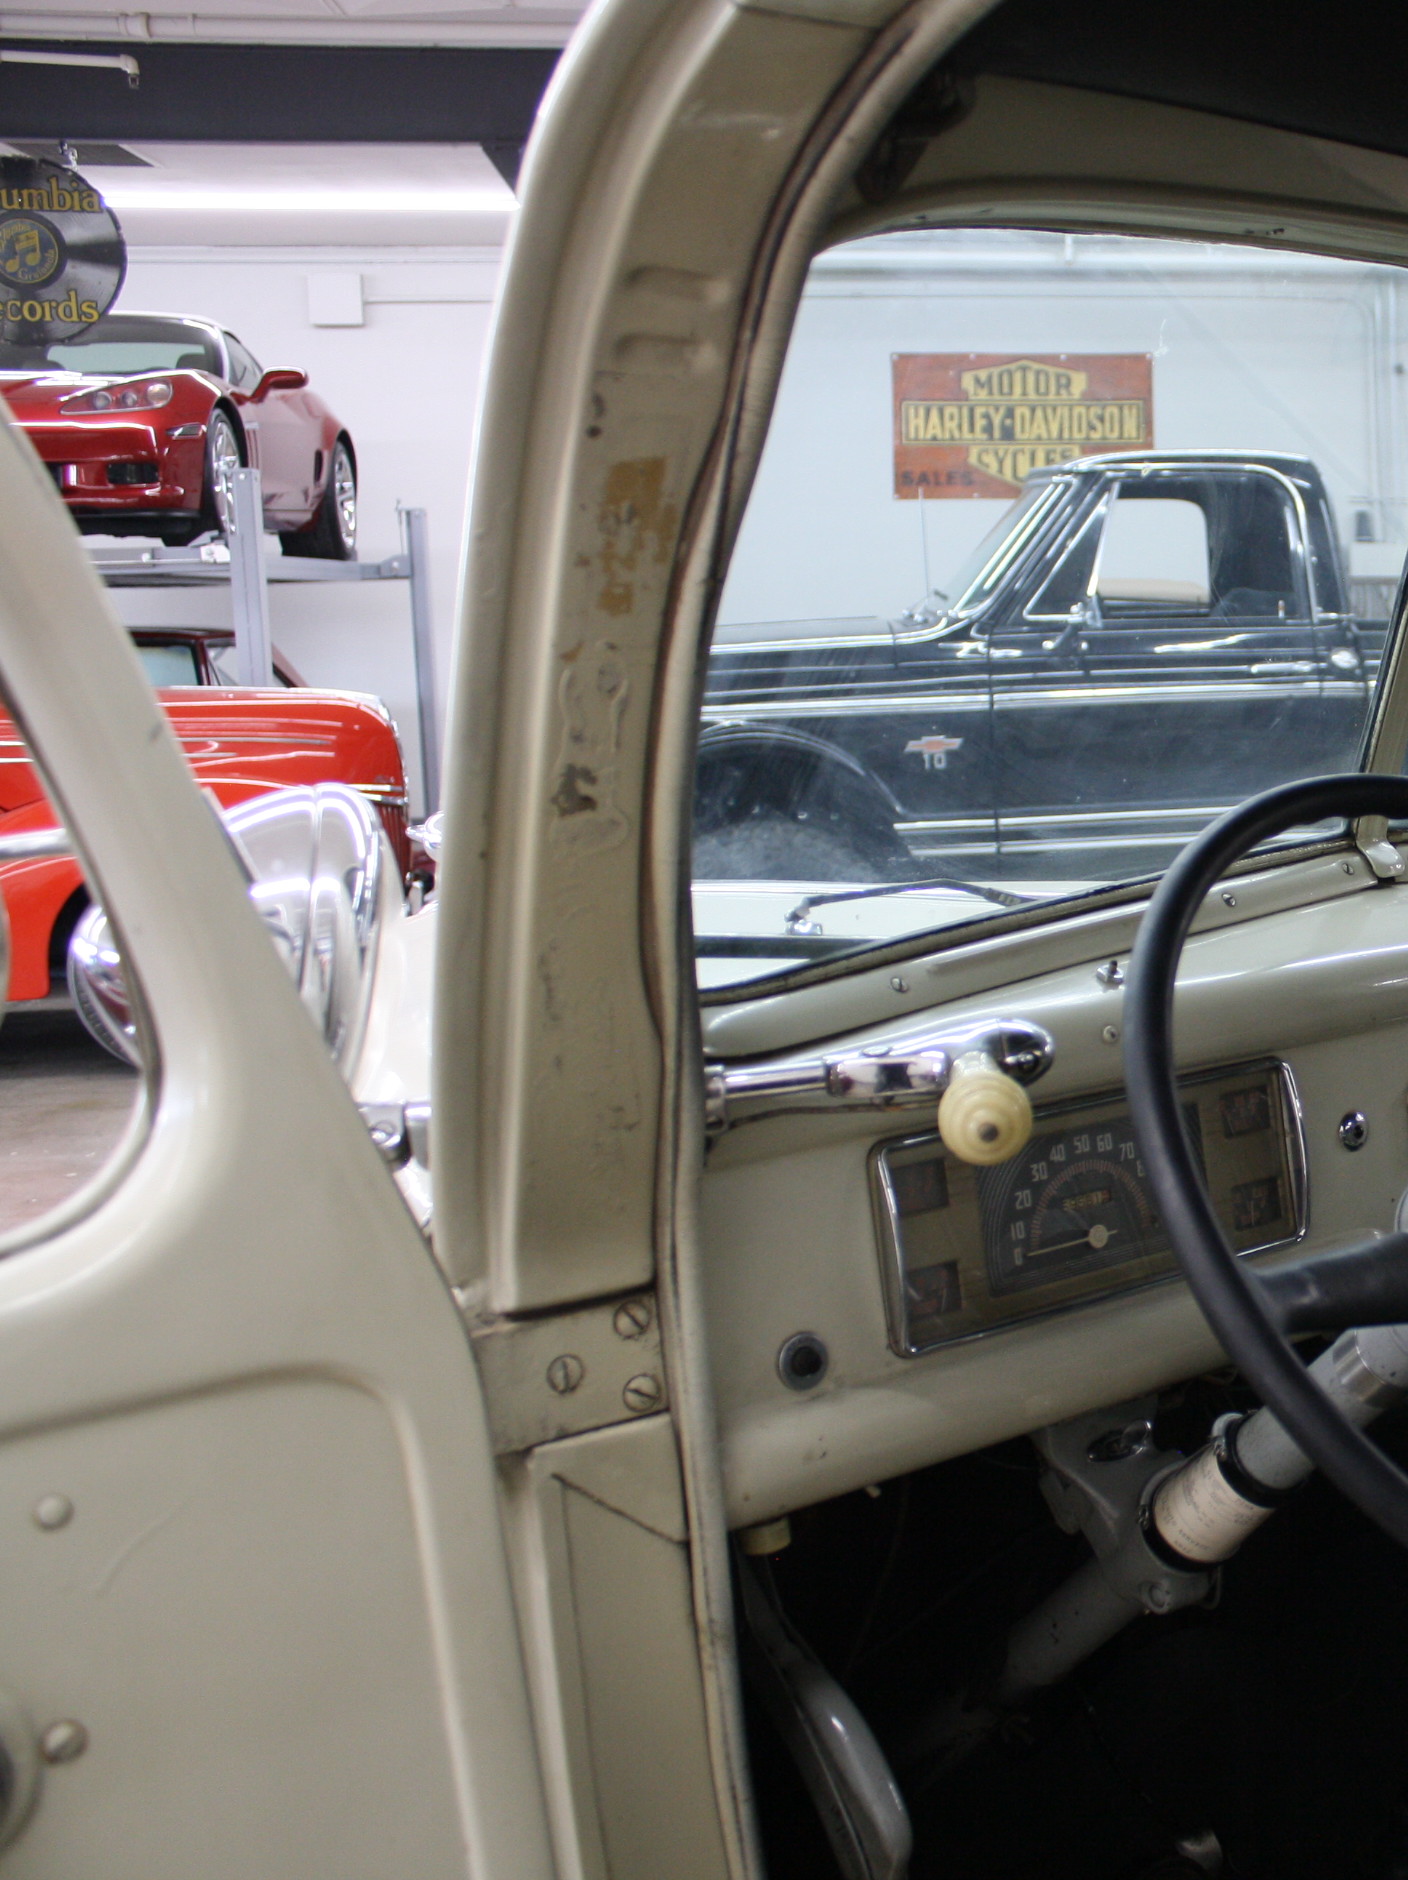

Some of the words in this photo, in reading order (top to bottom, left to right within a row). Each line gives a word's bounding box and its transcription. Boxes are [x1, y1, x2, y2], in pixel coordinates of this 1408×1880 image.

[0, 290, 99, 322] cords
[973, 365, 1073, 397] MOTOR
[906, 404, 1139, 440] HARLEY-DAVIDSON
[903, 471, 974, 486] SALES
[923, 753, 947, 770] 10
[1049, 1143, 1067, 1162] 40
[1073, 1134, 1091, 1154] 50
[1096, 1133, 1113, 1152] 60
[1119, 1142, 1136, 1161] 70
[1030, 1161, 1048, 1182] 30
[1014, 1189, 1032, 1210] 20
[1010, 1220, 1026, 1241] 10
